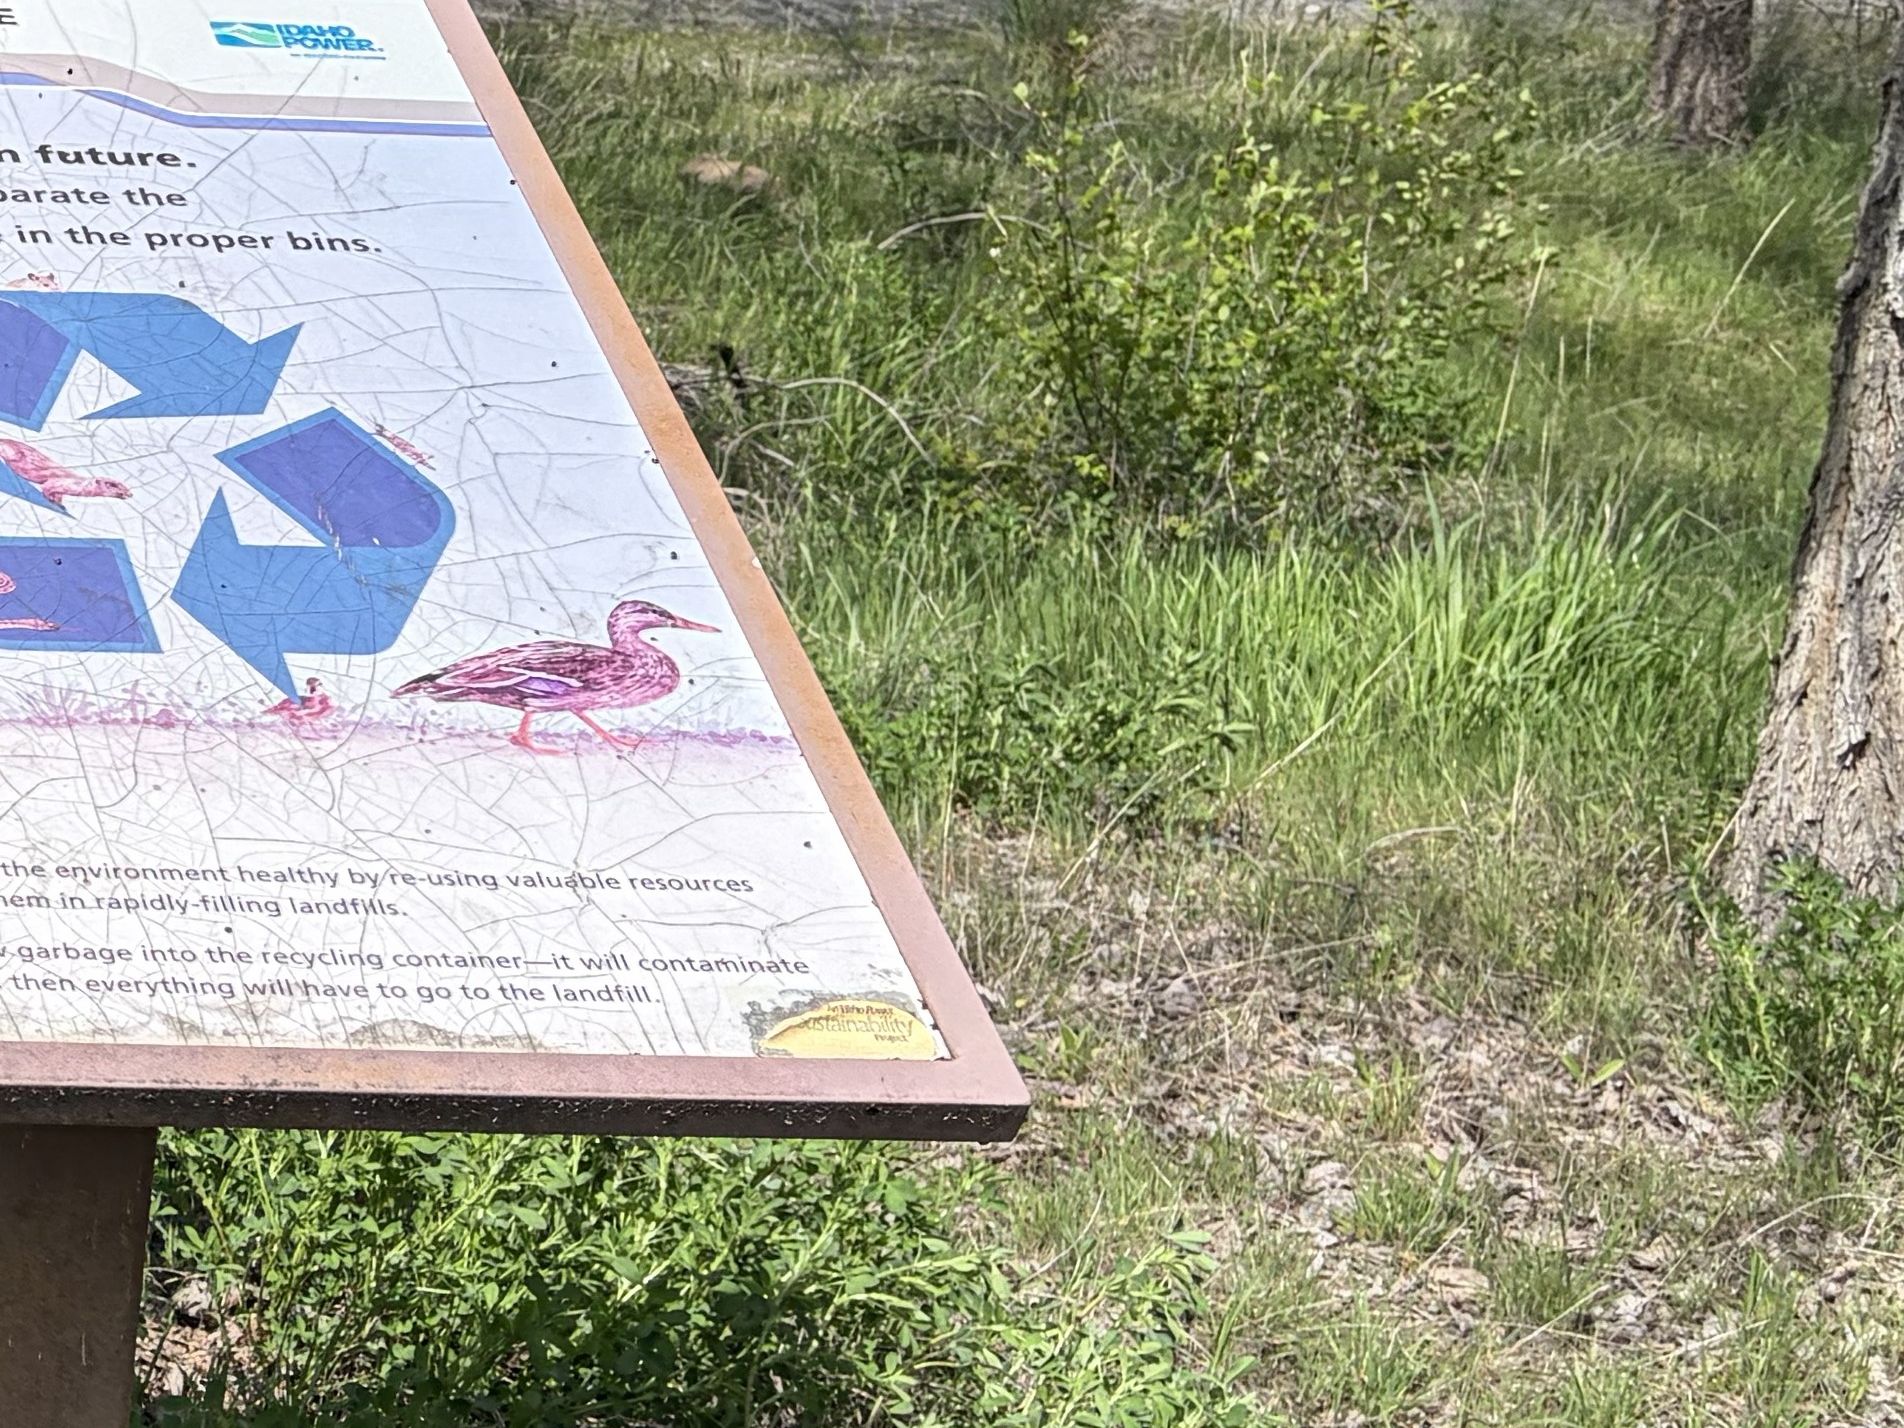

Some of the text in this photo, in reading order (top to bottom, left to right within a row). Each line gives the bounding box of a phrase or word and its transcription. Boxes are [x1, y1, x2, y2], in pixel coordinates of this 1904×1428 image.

[276, 23, 355, 38] IDAHO
[34, 144, 196, 168] future.
[122, 187, 187, 208] the
[15, 225, 53, 244] in
[64, 225, 133, 246] the
[144, 233, 274, 254] proper
[286, 230, 382, 253] bins.
[0, 860, 46, 878] the
[55, 864, 230, 882] environment
[236, 865, 338, 889] healthy
[347, 868, 379, 891] by
[388, 871, 499, 891] re-using
[505, 872, 621, 889] valuable
[628, 877, 753, 893] resources
[59, 892, 86, 910] in
[95, 893, 281, 918] rapidly-filling
[288, 897, 407, 916] landfills.
[18, 943, 132, 963] garbage
[141, 944, 197, 963] into
[204, 946, 253, 964] the
[261, 948, 384, 970] recycling
[579, 953, 630, 971] will
[638, 957, 809, 974] contaminate
[10, 974, 75, 992] then
[85, 976, 236, 1000] everything
[245, 979, 293, 997] will
[301, 982, 369, 998] have
[376, 984, 407, 999] to
[416, 987, 453, 1004] go
[459, 984, 490, 1000] to
[497, 984, 545, 1001] the
[552, 984, 661, 1003] landfill.
